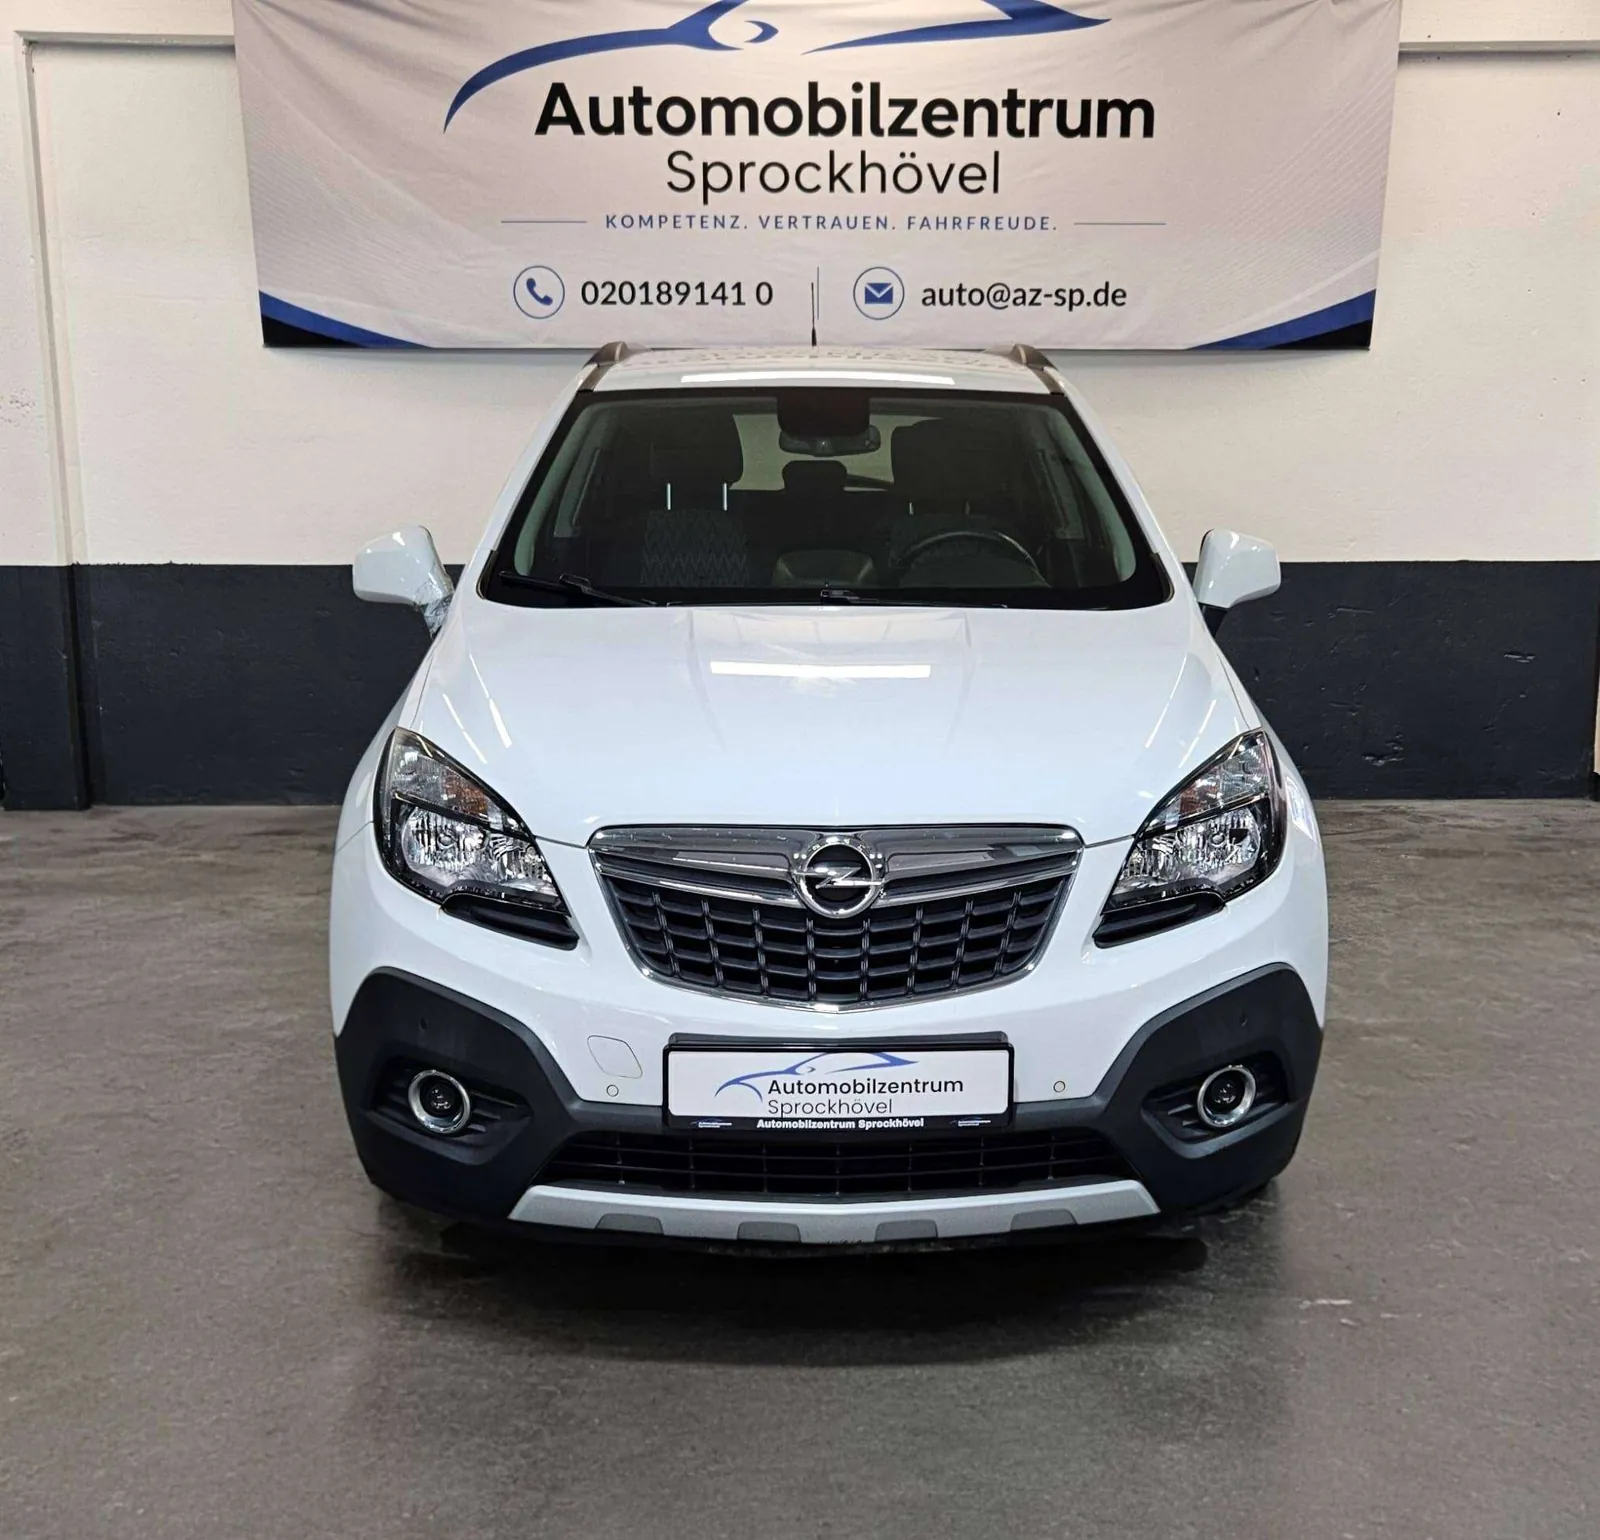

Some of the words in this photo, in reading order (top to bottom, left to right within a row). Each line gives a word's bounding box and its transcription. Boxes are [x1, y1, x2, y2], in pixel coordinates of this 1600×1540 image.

[535, 81, 1155, 139] Automobilzentrum
[666, 149, 1001, 205] Sprockhövel
[605, 214, 749, 230] KOMPETENZ.
[759, 215, 896, 231] VERTRAUEN.
[907, 215, 1057, 232] FAHRFREUDE.
[921, 280, 1127, 312] auto@az-sp.de
[767, 1078, 964, 1095] Automobilzentrum
[767, 1099, 893, 1118] Sprockhövel
[756, 1119, 856, 1130] Automobilzentrum
[858, 1117, 925, 1131] Sprockhövel
